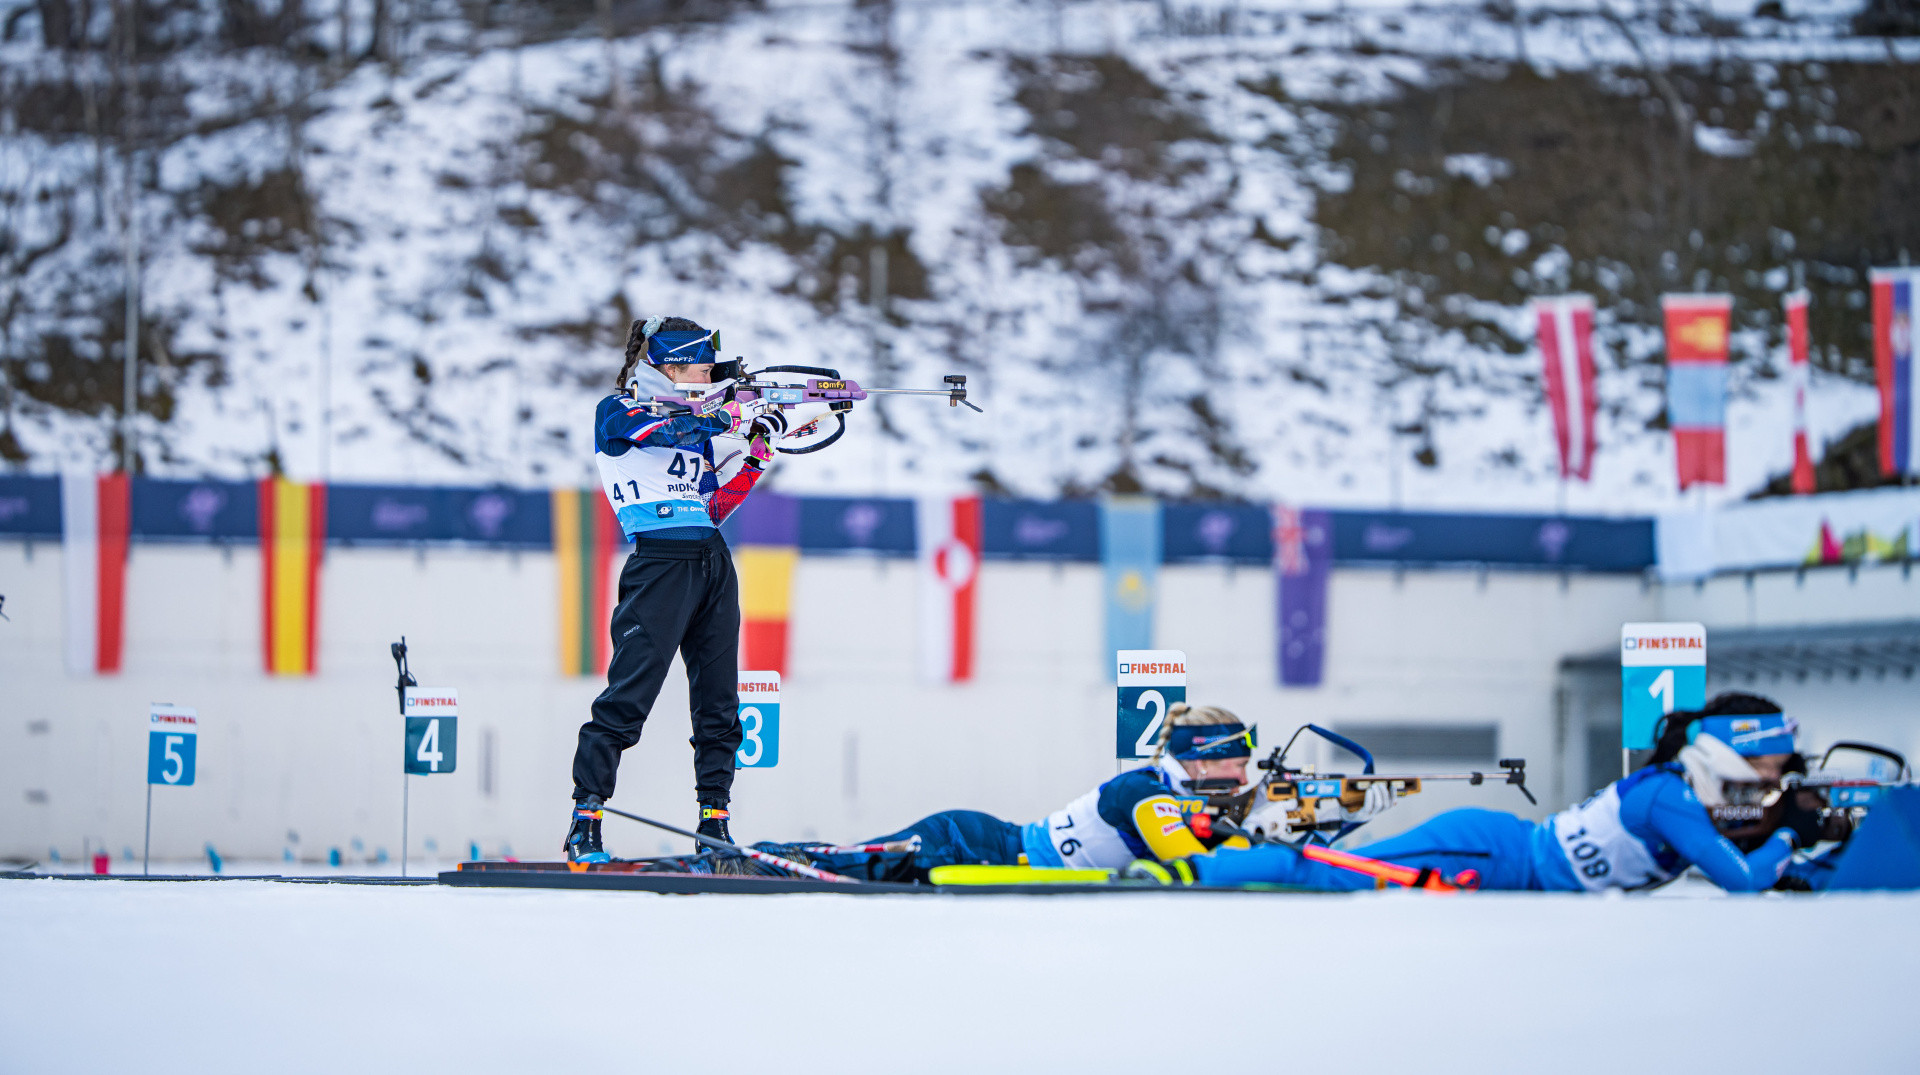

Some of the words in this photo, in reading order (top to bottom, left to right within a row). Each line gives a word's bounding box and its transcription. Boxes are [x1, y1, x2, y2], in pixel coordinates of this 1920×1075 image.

[818, 381, 845, 390] somfy
[667, 452, 701, 483] 41
[613, 479, 640, 503] 41
[1638, 637, 1704, 649] FINSTRAL
[1130, 663, 1186, 674] FINSTRAL
[415, 697, 457, 706] FINSTRAL
[737, 682, 780, 692] INSTRAL
[1648, 669, 1674, 714] 1
[737, 706, 763, 766] 3
[1135, 689, 1166, 756] 2
[162, 735, 184, 784] 5
[416, 718, 443, 772] 4
[1055, 815, 1083, 857] 76
